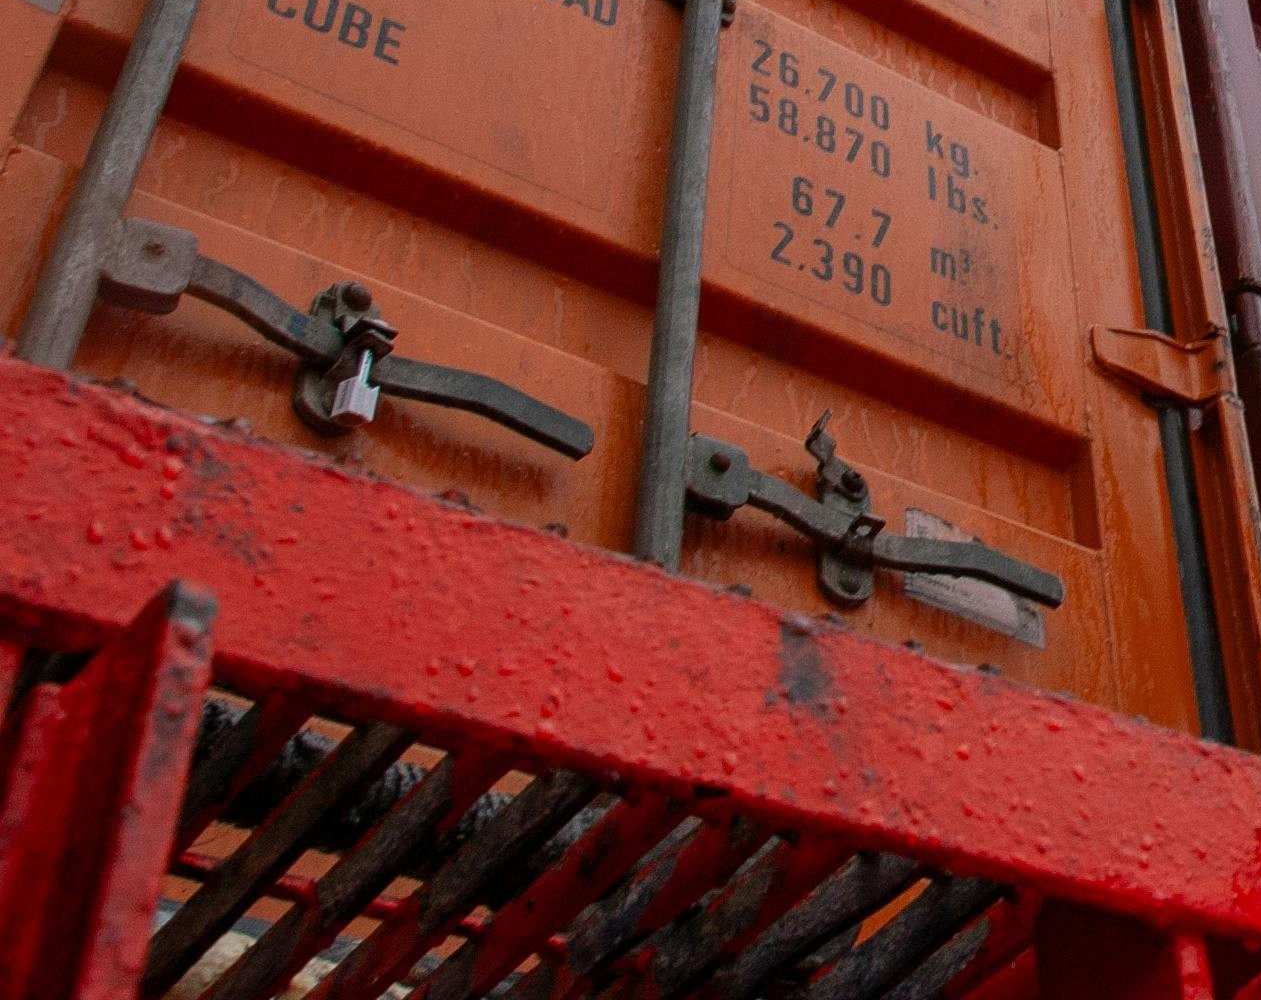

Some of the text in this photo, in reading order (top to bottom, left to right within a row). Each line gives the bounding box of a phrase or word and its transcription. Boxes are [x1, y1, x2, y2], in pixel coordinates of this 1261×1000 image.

[751, 39, 891, 131] 26.700
[749, 83, 999, 231] 58.870 lbs.
[792, 176, 891, 248] 67.7
[770, 220, 1013, 360] 2.390 cuft.
